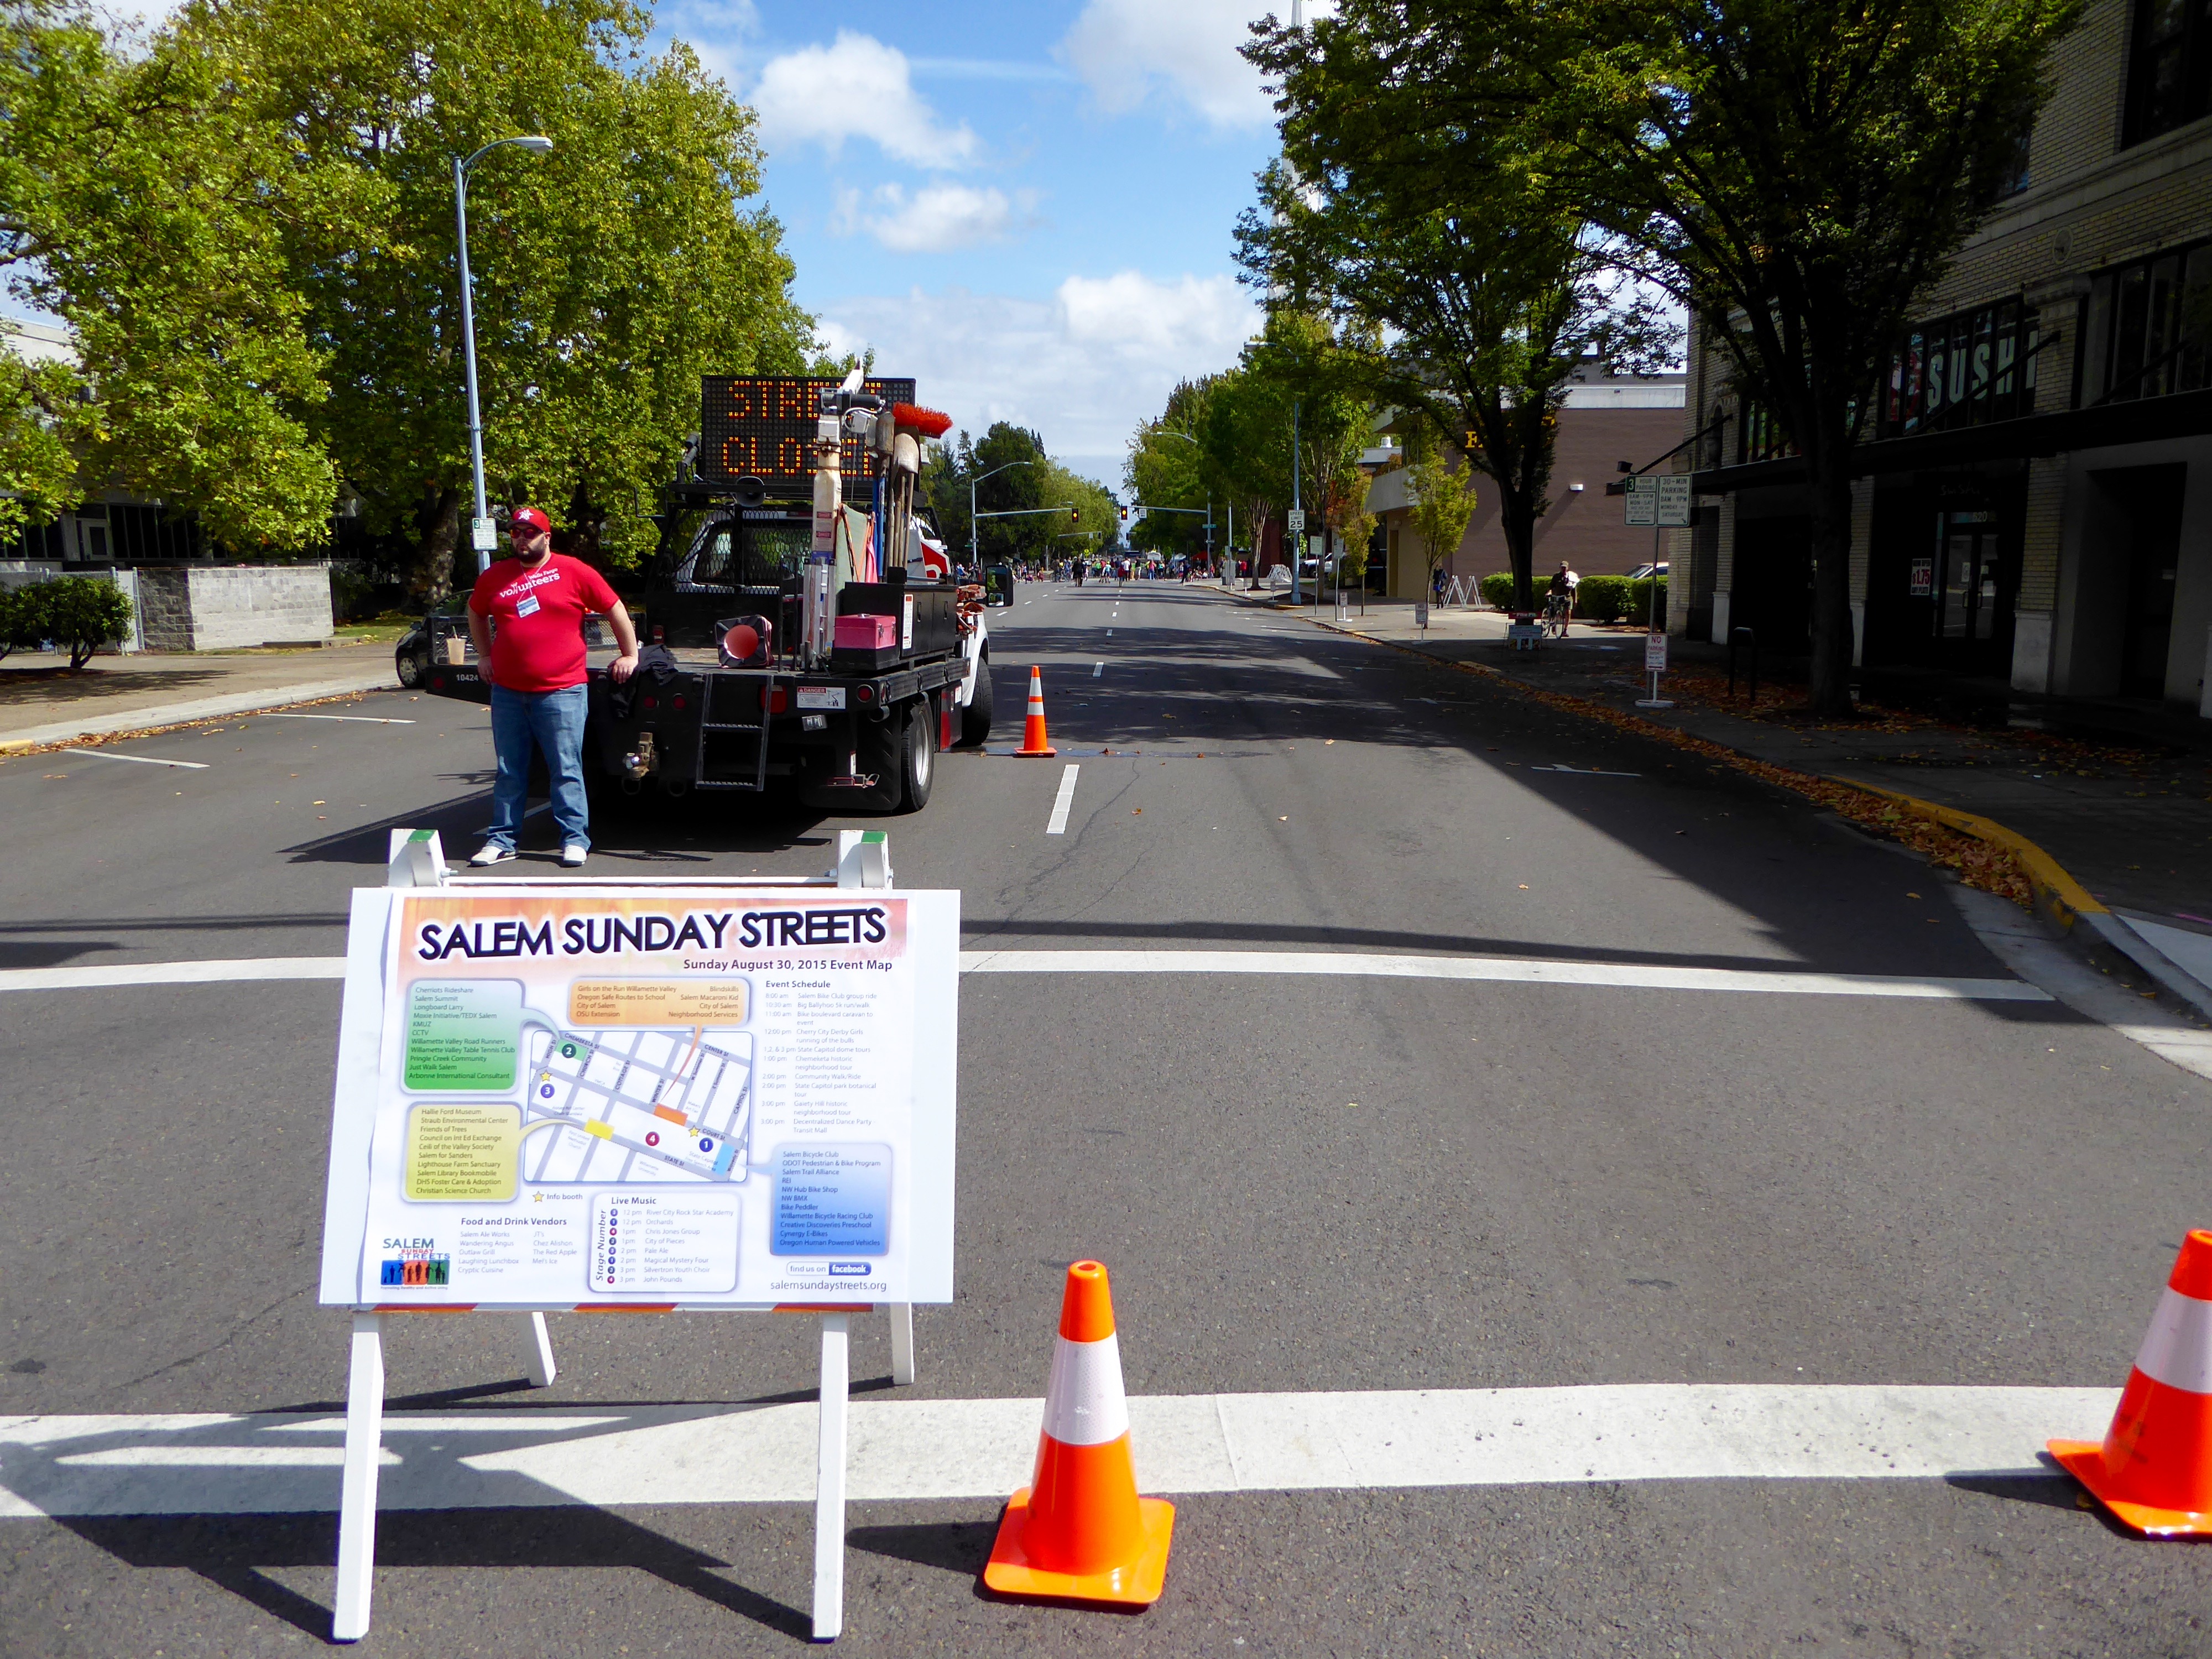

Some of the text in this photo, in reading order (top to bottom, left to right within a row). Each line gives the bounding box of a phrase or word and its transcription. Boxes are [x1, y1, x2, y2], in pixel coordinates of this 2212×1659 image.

[1927, 330, 2039, 414] SUSHI
[728, 380, 881, 419] STRET
[1629, 478, 1634, 491] 3
[1913, 569, 1929, 585] $1.75
[499, 573, 560, 598] volunteers
[418, 907, 886, 961] SALEM SUNDAY STREETS
[684, 959, 893, 972] Sunday August 30, 2015 Event Map
[649, 1135, 656, 1143] 4
[780, 1230, 805, 1239] Cynergy
[383, 1238, 434, 1249] SALEM
[596, 1209, 606, 1281] Stage Number
[771, 1280, 886, 1292] salemsundaystreets.org
